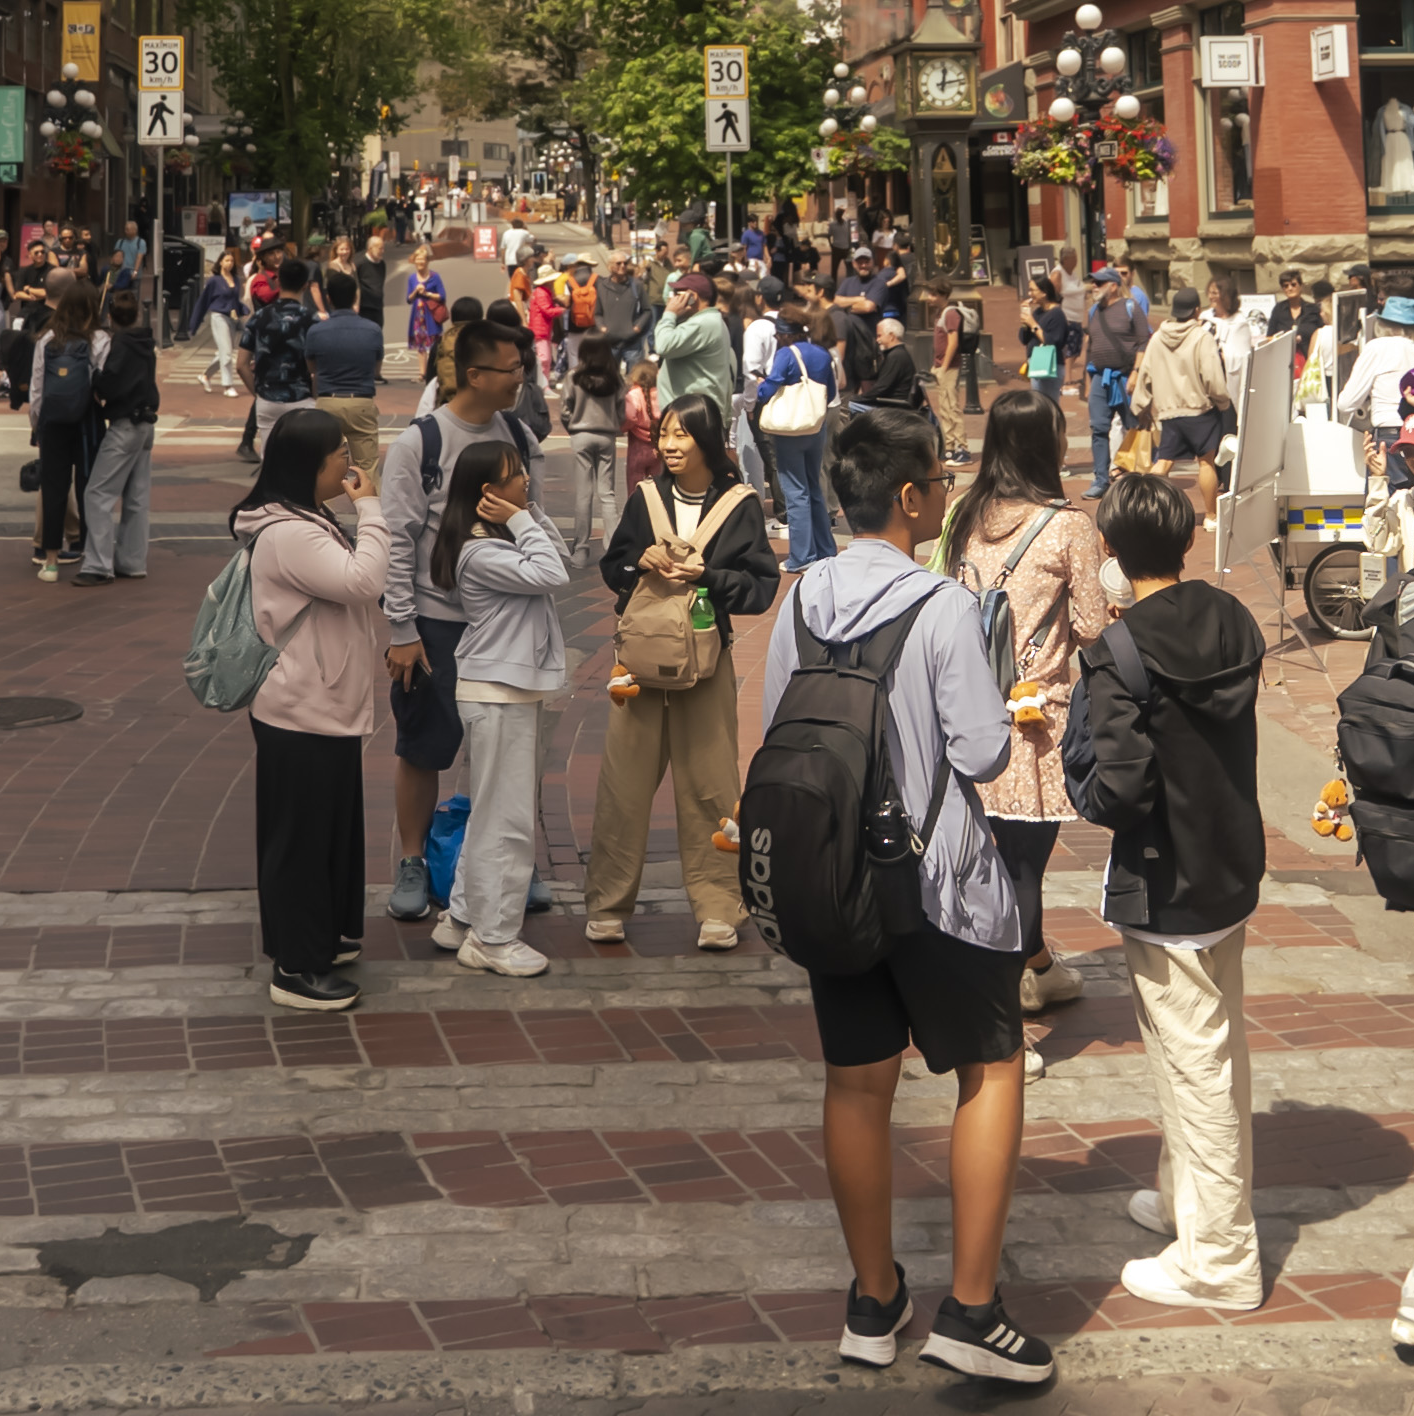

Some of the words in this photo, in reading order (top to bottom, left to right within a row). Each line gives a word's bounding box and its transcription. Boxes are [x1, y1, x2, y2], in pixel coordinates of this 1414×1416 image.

[144, 51, 179, 74] 30
[1218, 60, 1242, 69] SCOOP
[710, 60, 743, 83] 30
[149, 75, 173, 84] km/h
[716, 84, 739, 93] km/h
